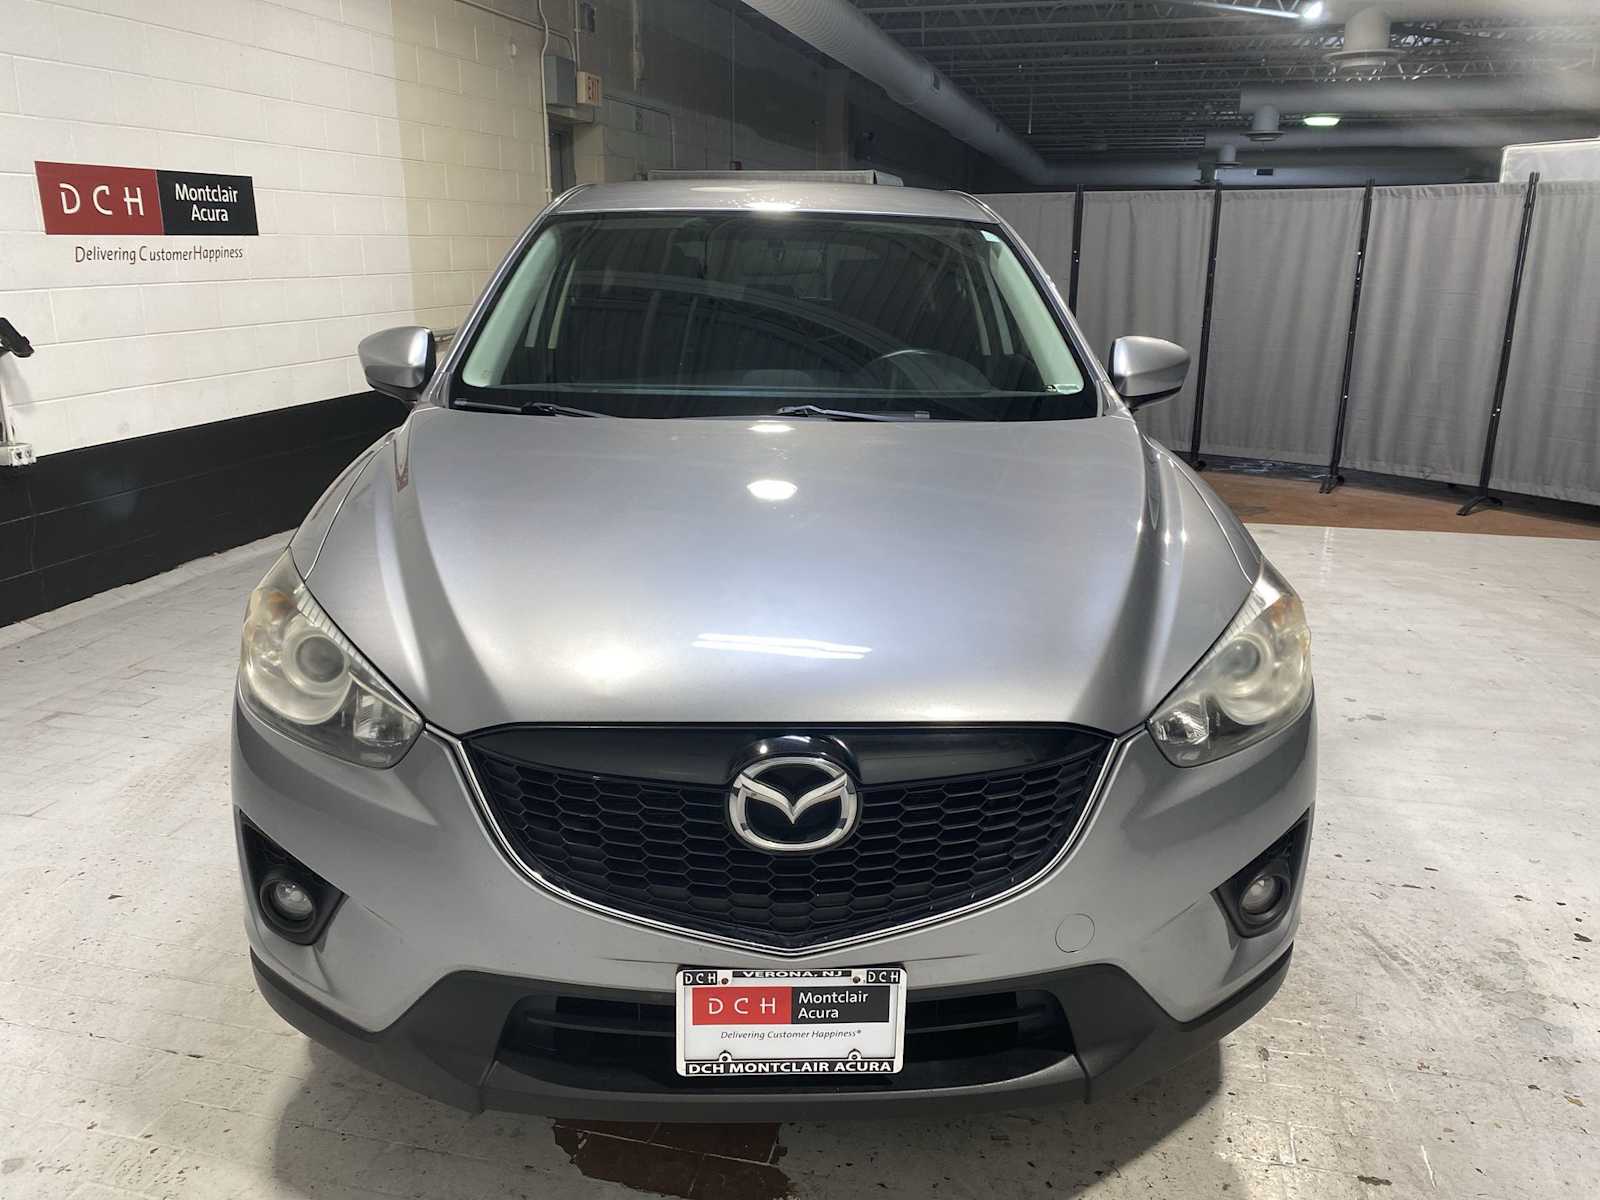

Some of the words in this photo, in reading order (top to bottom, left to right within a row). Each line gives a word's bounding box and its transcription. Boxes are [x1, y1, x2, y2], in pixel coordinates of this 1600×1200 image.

[59, 183, 145, 216] DCH
[175, 183, 239, 203] Montclair
[191, 204, 229, 222] Acura
[75, 246, 136, 264] Delivering
[684, 972, 716, 985] DCH
[868, 970, 899, 983] DCH
[798, 991, 869, 1005] Montclair
[708, 997, 776, 1015] DCH
[798, 1007, 839, 1019] Acura
[720, 1030, 765, 1041] Delivering
[767, 1029, 809, 1039] Customer
[688, 1063, 724, 1074] DCH
[729, 1062, 830, 1073] MONTCLAIR
[834, 1061, 892, 1072] ACURA
